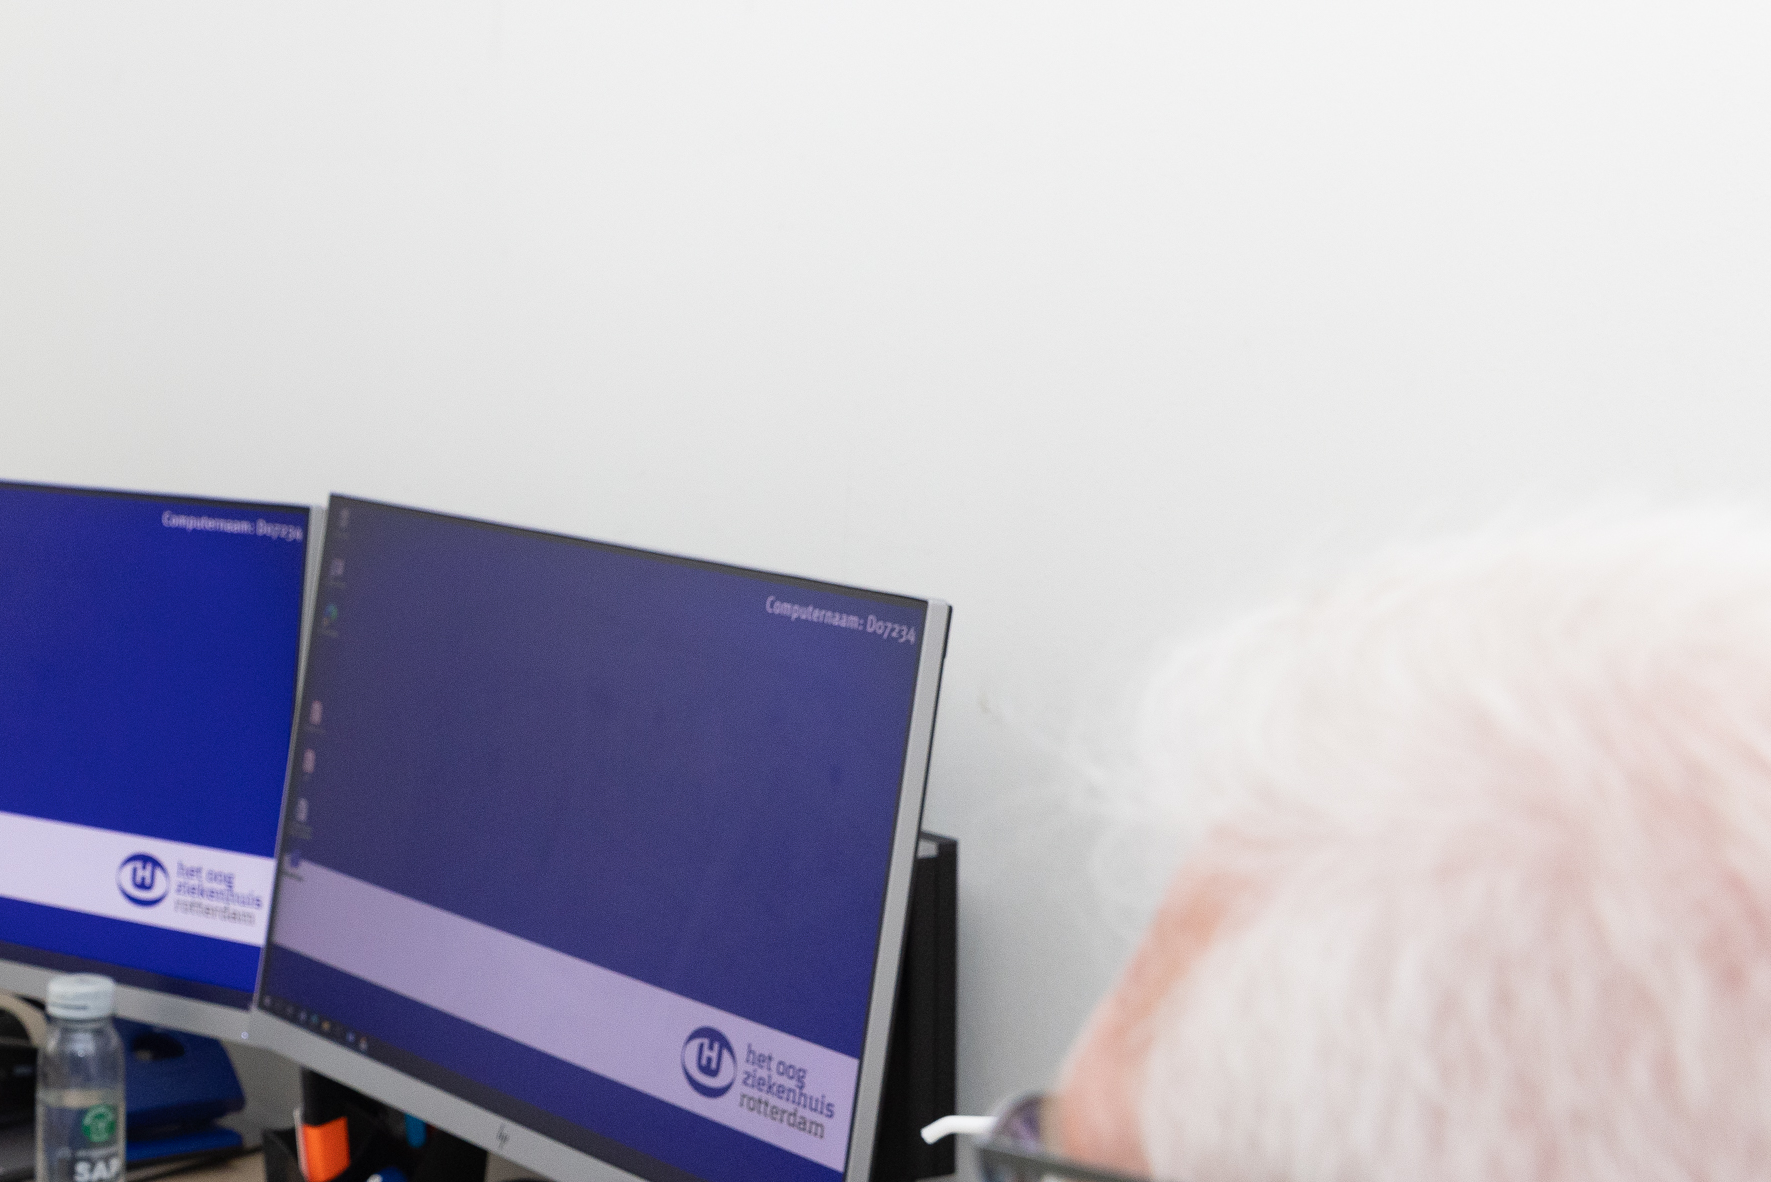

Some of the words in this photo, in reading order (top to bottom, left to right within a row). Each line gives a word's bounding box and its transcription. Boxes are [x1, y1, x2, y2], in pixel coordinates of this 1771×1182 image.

[765, 595, 864, 631] Computernaam:
[174, 899, 255, 926] rotterdam
[176, 880, 262, 909] ziekenhuis
[745, 1043, 773, 1071] het
[776, 1060, 807, 1089] oog
[742, 1069, 835, 1119] ziekenhuis
[739, 1092, 825, 1139] rotterdam
